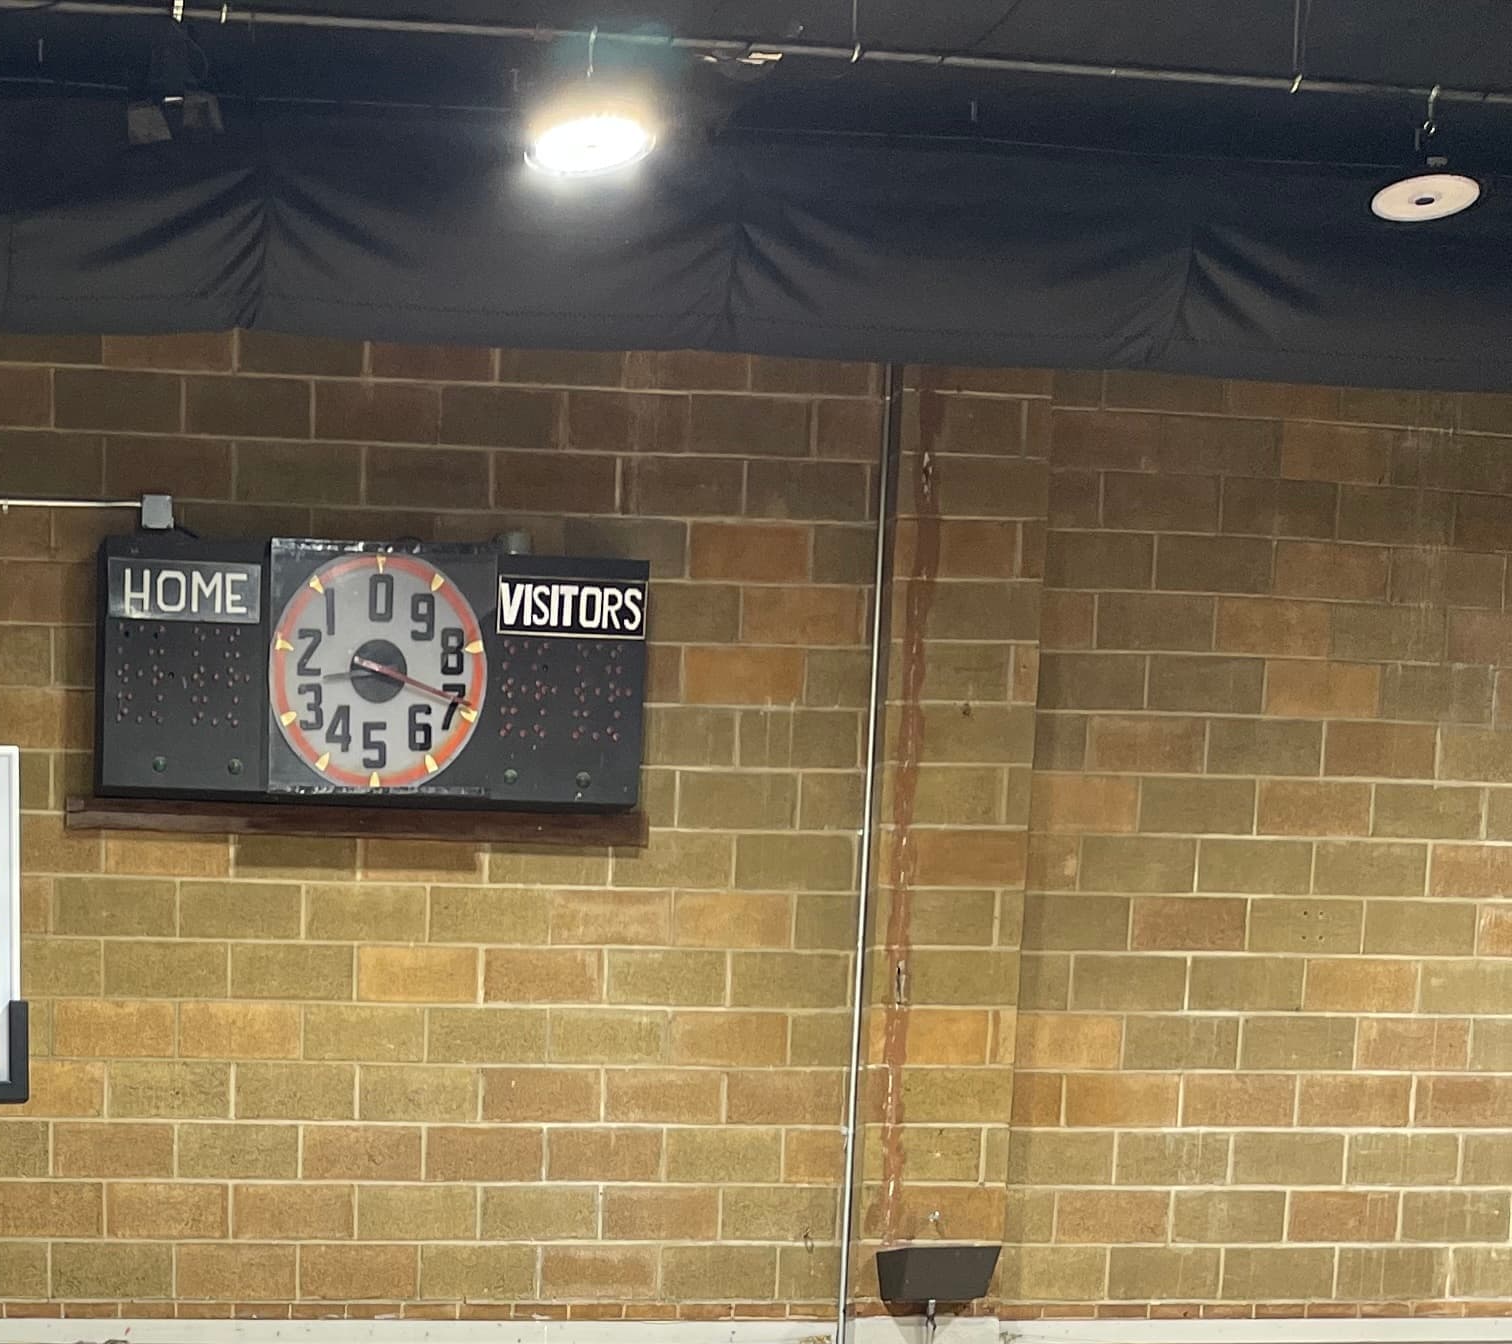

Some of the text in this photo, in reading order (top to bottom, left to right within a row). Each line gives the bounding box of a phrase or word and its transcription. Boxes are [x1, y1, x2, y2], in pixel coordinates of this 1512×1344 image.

[124, 567, 248, 615] HOME
[368, 574, 394, 622] 0
[500, 582, 643, 631] VISITORS
[410, 592, 435, 641] 9
[296, 628, 322, 676] 2
[440, 627, 465, 676] 8
[297, 683, 324, 731] 3
[325, 705, 352, 753] 4
[408, 704, 432, 751] 6
[442, 683, 466, 731] 7
[362, 721, 387, 769] 5
